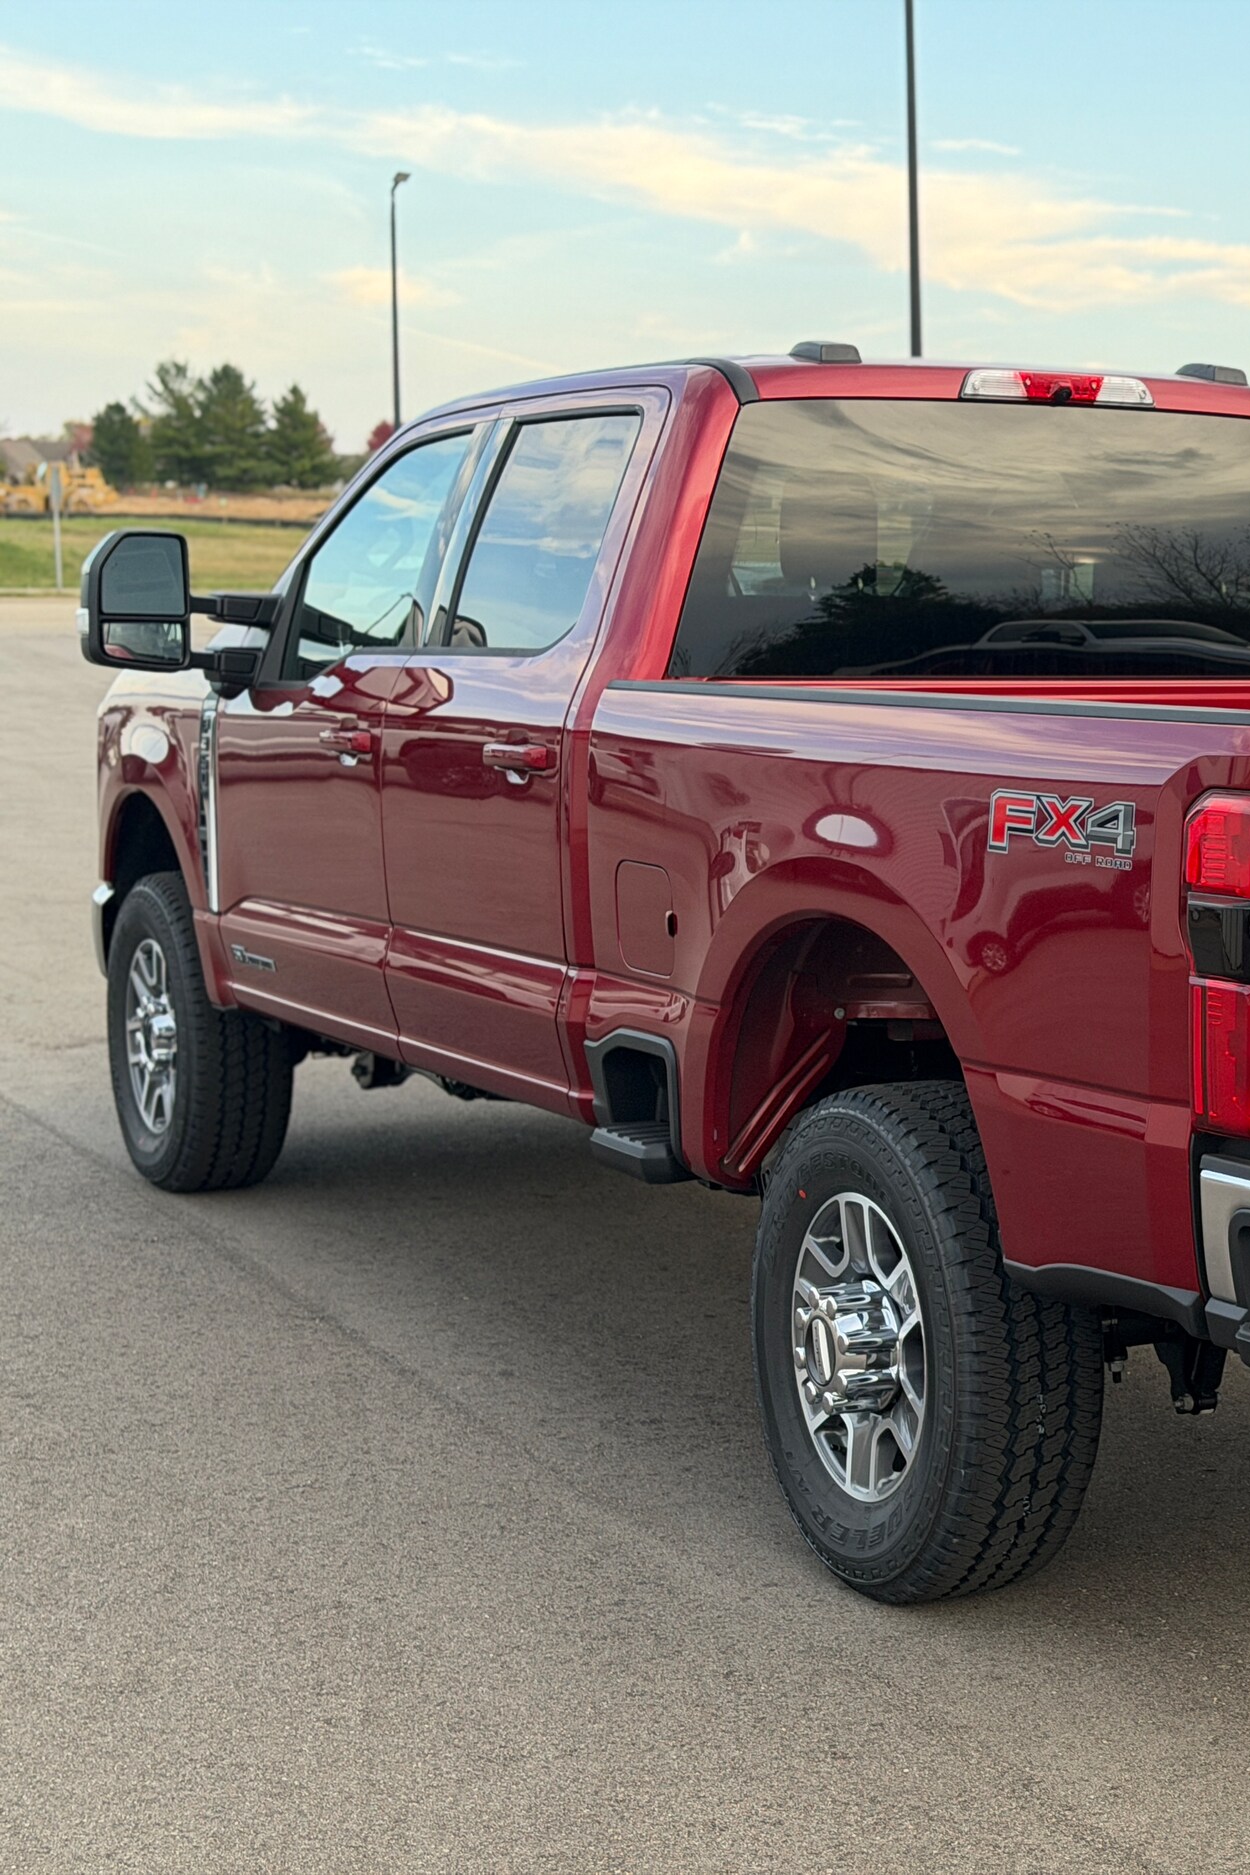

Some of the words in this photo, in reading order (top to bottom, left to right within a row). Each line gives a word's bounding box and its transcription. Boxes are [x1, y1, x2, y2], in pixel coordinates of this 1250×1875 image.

[987, 788, 1136, 857] FX4
[1064, 852, 1091, 865] OFF
[1095, 855, 1132, 871] ROAD
